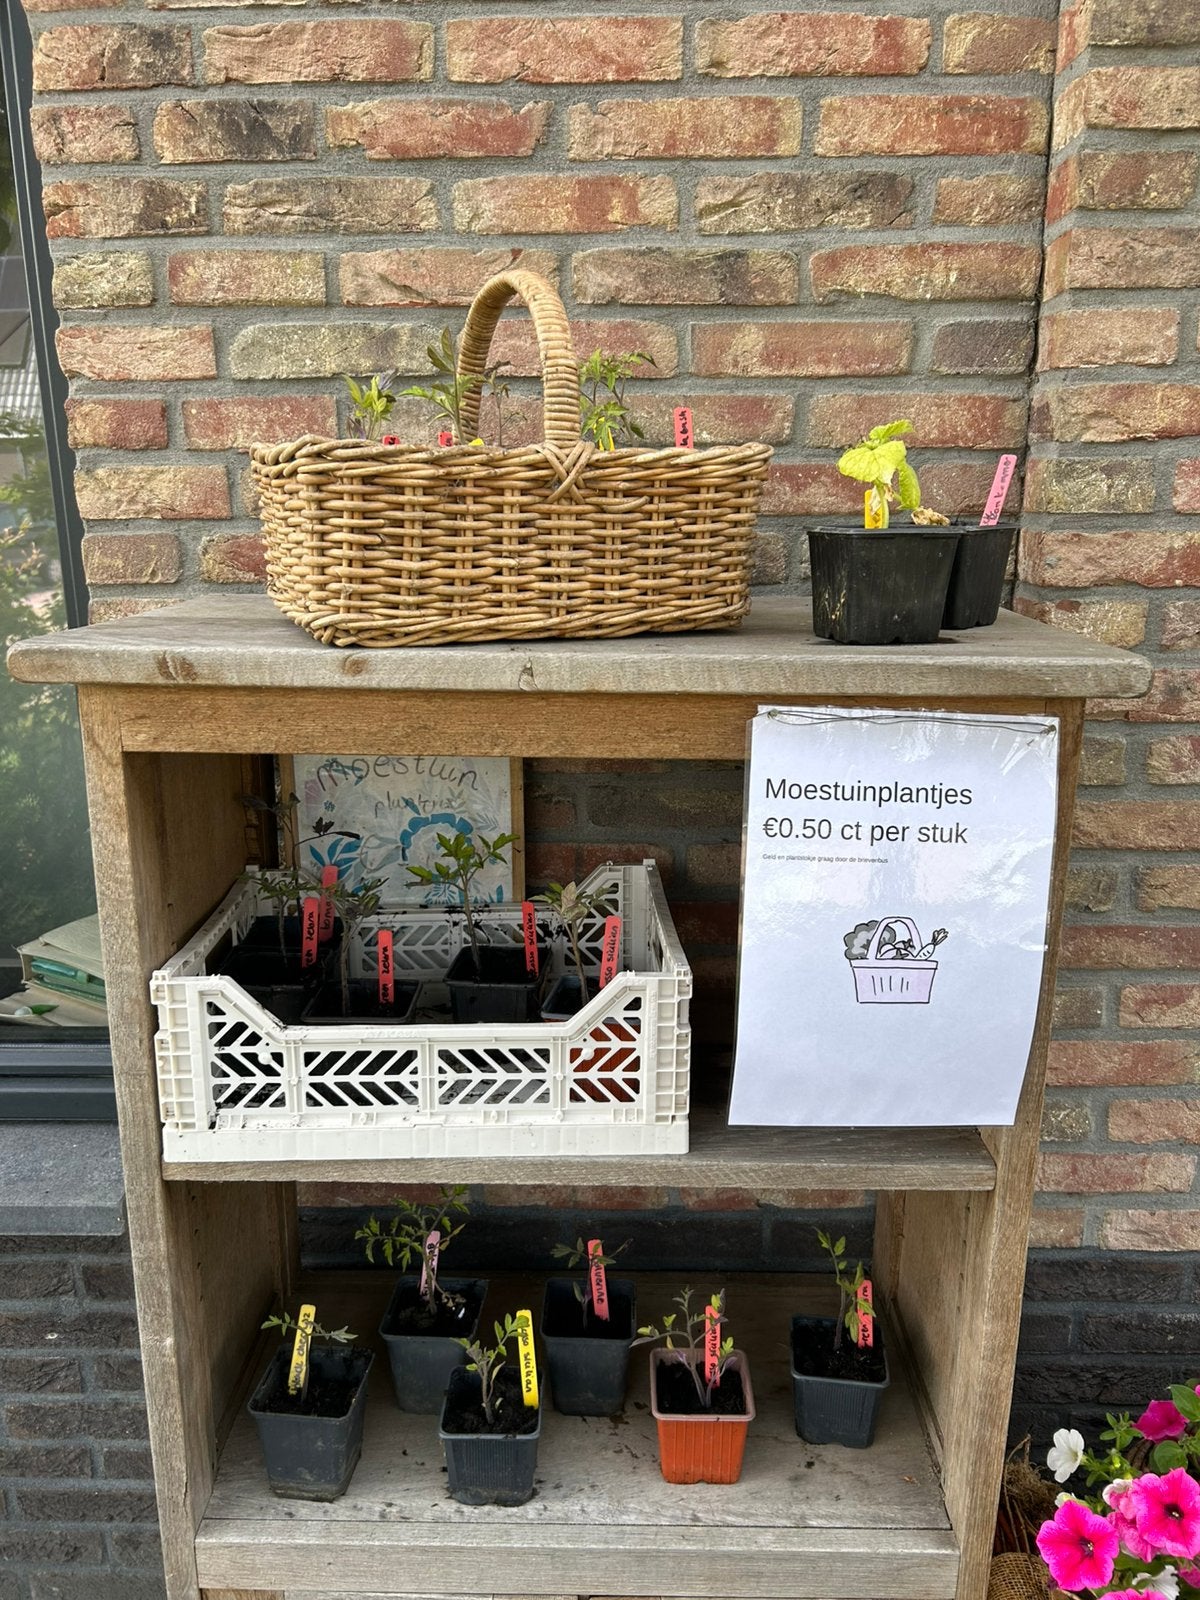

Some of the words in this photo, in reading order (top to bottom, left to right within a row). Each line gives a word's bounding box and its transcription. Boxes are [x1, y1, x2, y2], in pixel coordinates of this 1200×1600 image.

[765, 778, 973, 809] Moestuinplantjes
[762, 817, 832, 839] €0.50
[841, 820, 862, 841] ct
[870, 823, 909, 847] per
[917, 822, 968, 844] stuk
